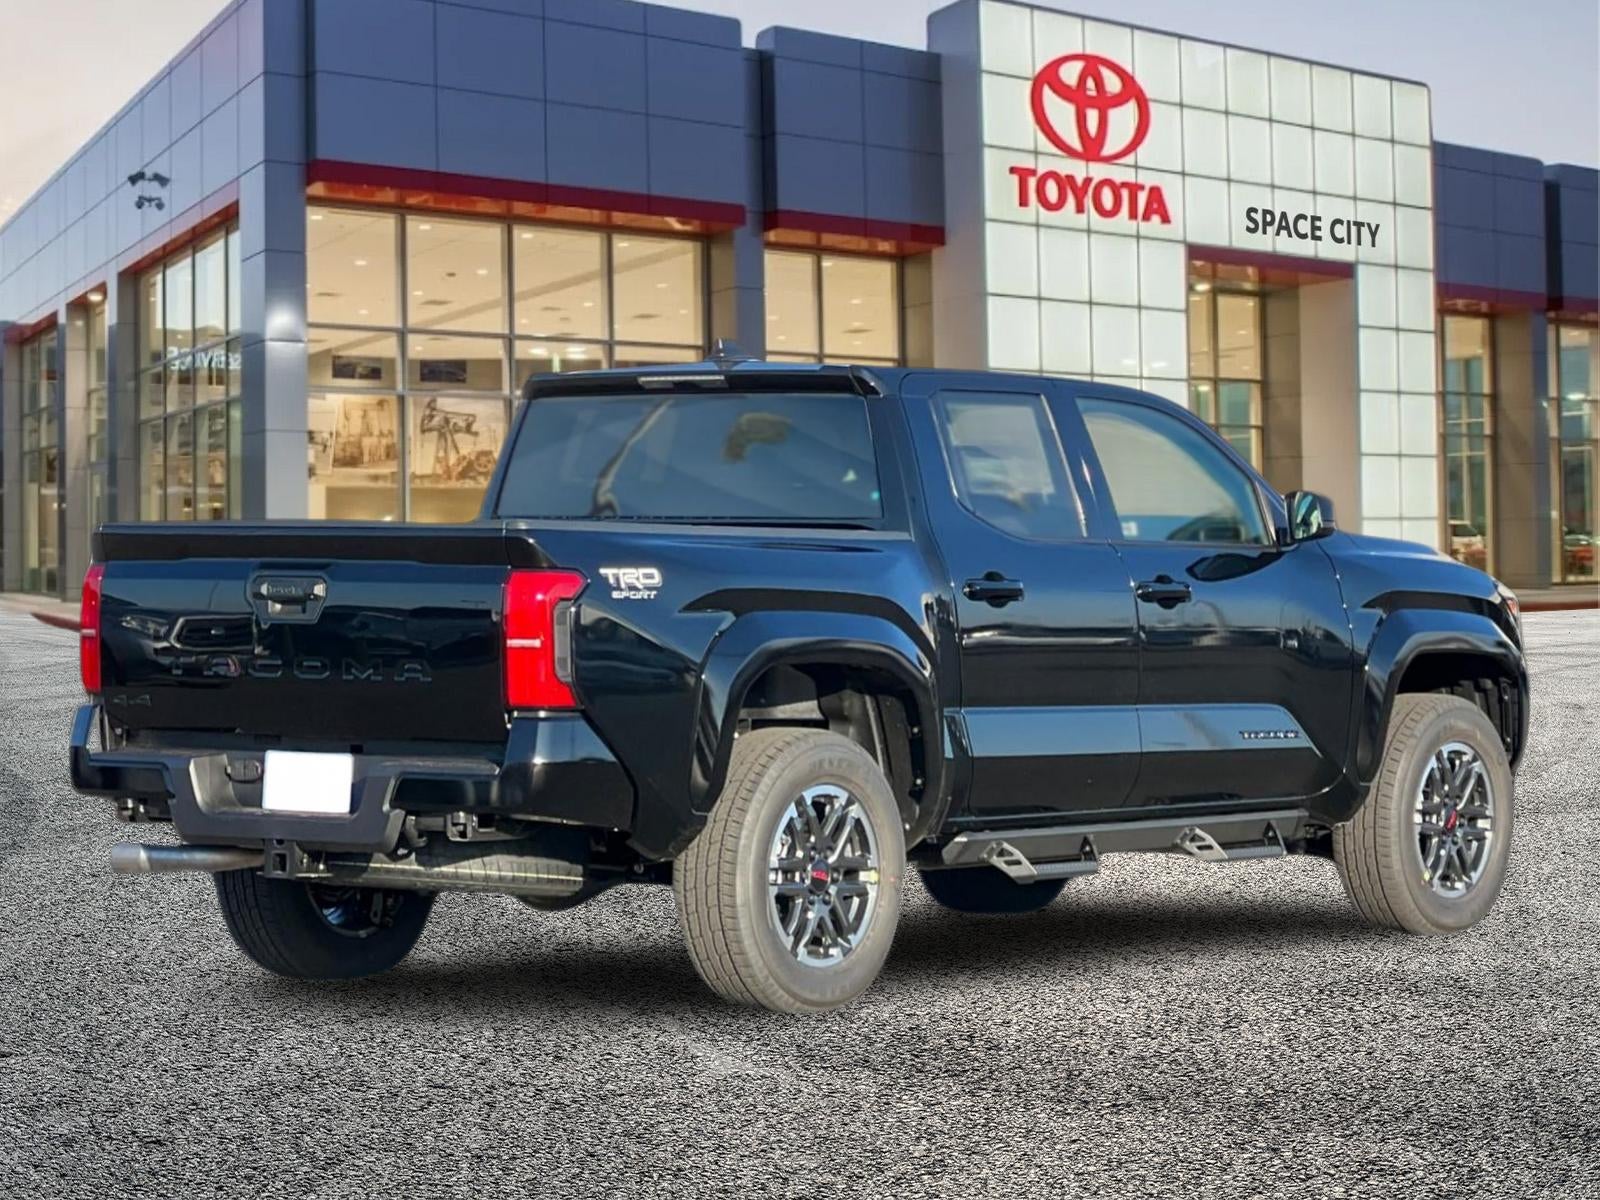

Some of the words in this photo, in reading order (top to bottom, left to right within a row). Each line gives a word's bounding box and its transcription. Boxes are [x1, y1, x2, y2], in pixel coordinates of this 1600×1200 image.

[1009, 166, 1171, 224] TOYOTA
[1246, 206, 1322, 242] SPACE
[1329, 218, 1380, 248] CITY
[599, 567, 662, 589] TRD
[611, 590, 657, 599] SPORT
[159, 655, 432, 682] TACOMA
